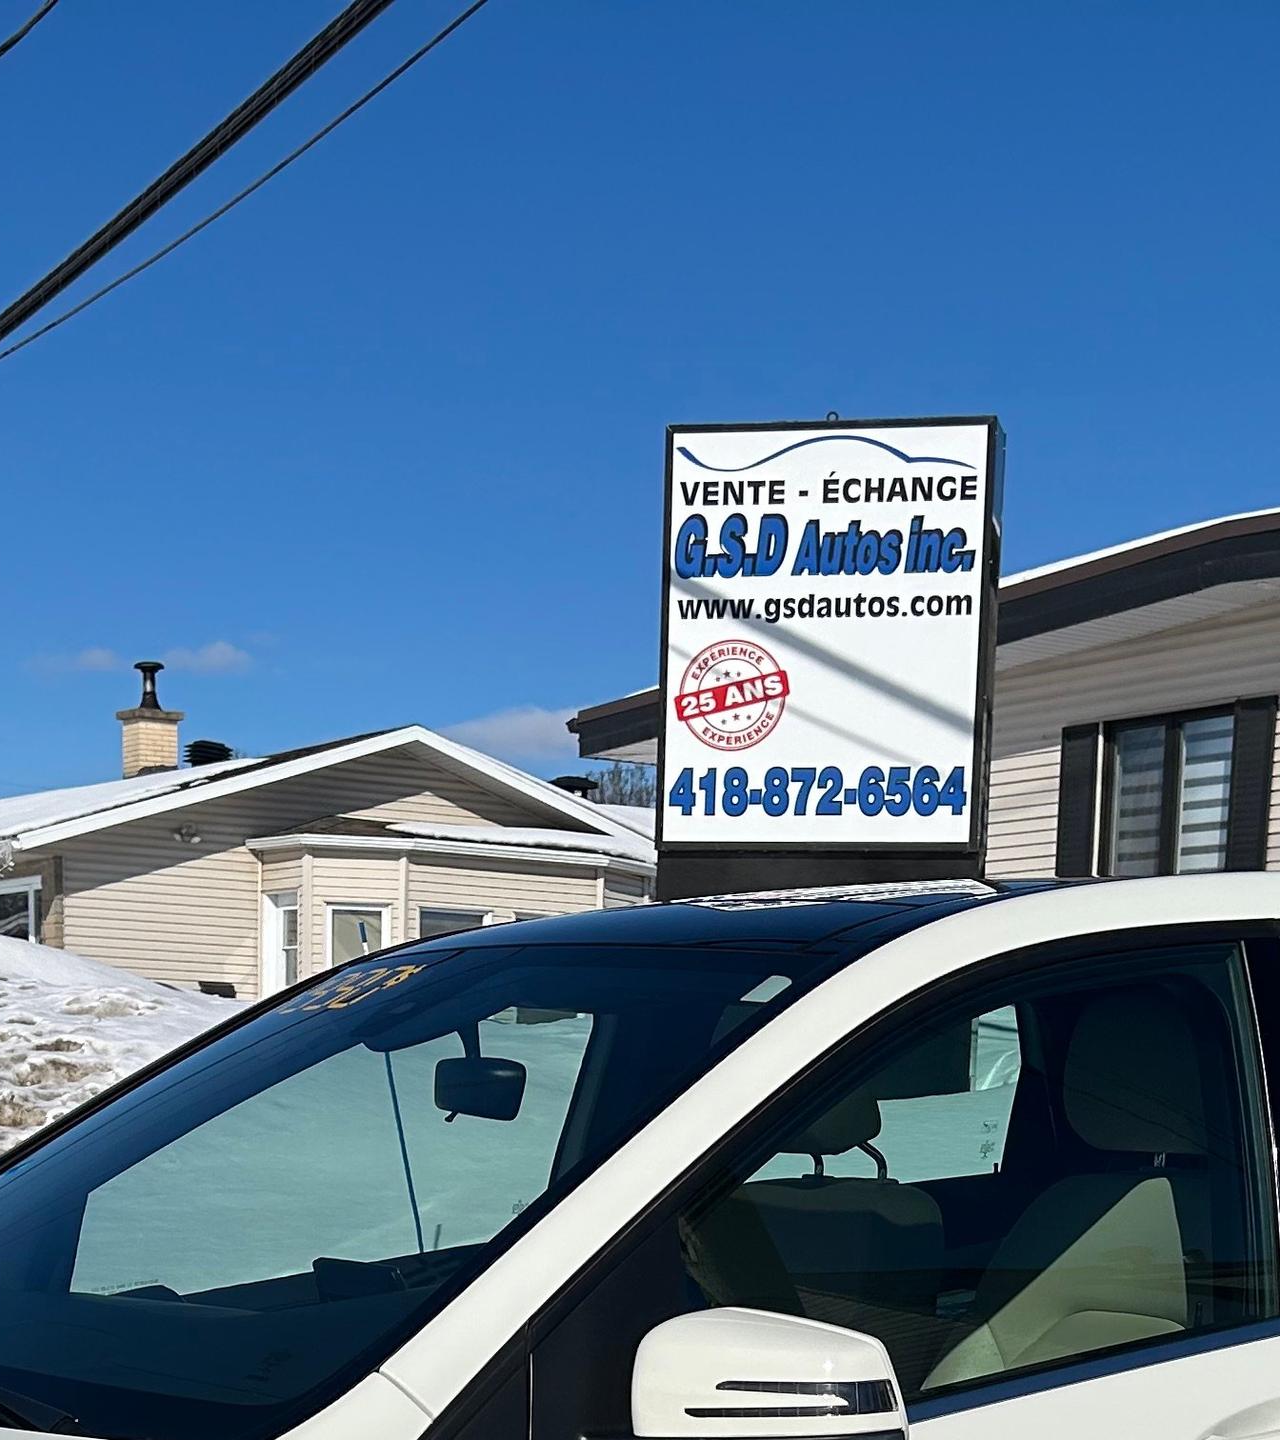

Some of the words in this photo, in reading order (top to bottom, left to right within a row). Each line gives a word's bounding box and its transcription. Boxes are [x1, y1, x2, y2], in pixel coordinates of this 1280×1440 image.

[680, 480, 785, 506] VENTE
[822, 471, 977, 503] ÉCHANGE
[675, 513, 789, 579] G.S.D
[791, 519, 903, 576] Autos
[677, 593, 972, 624] www.gsdautos.com
[680, 691, 717, 718] 25
[724, 674, 785, 707] ANS
[669, 766, 967, 817] 418-872-6564
